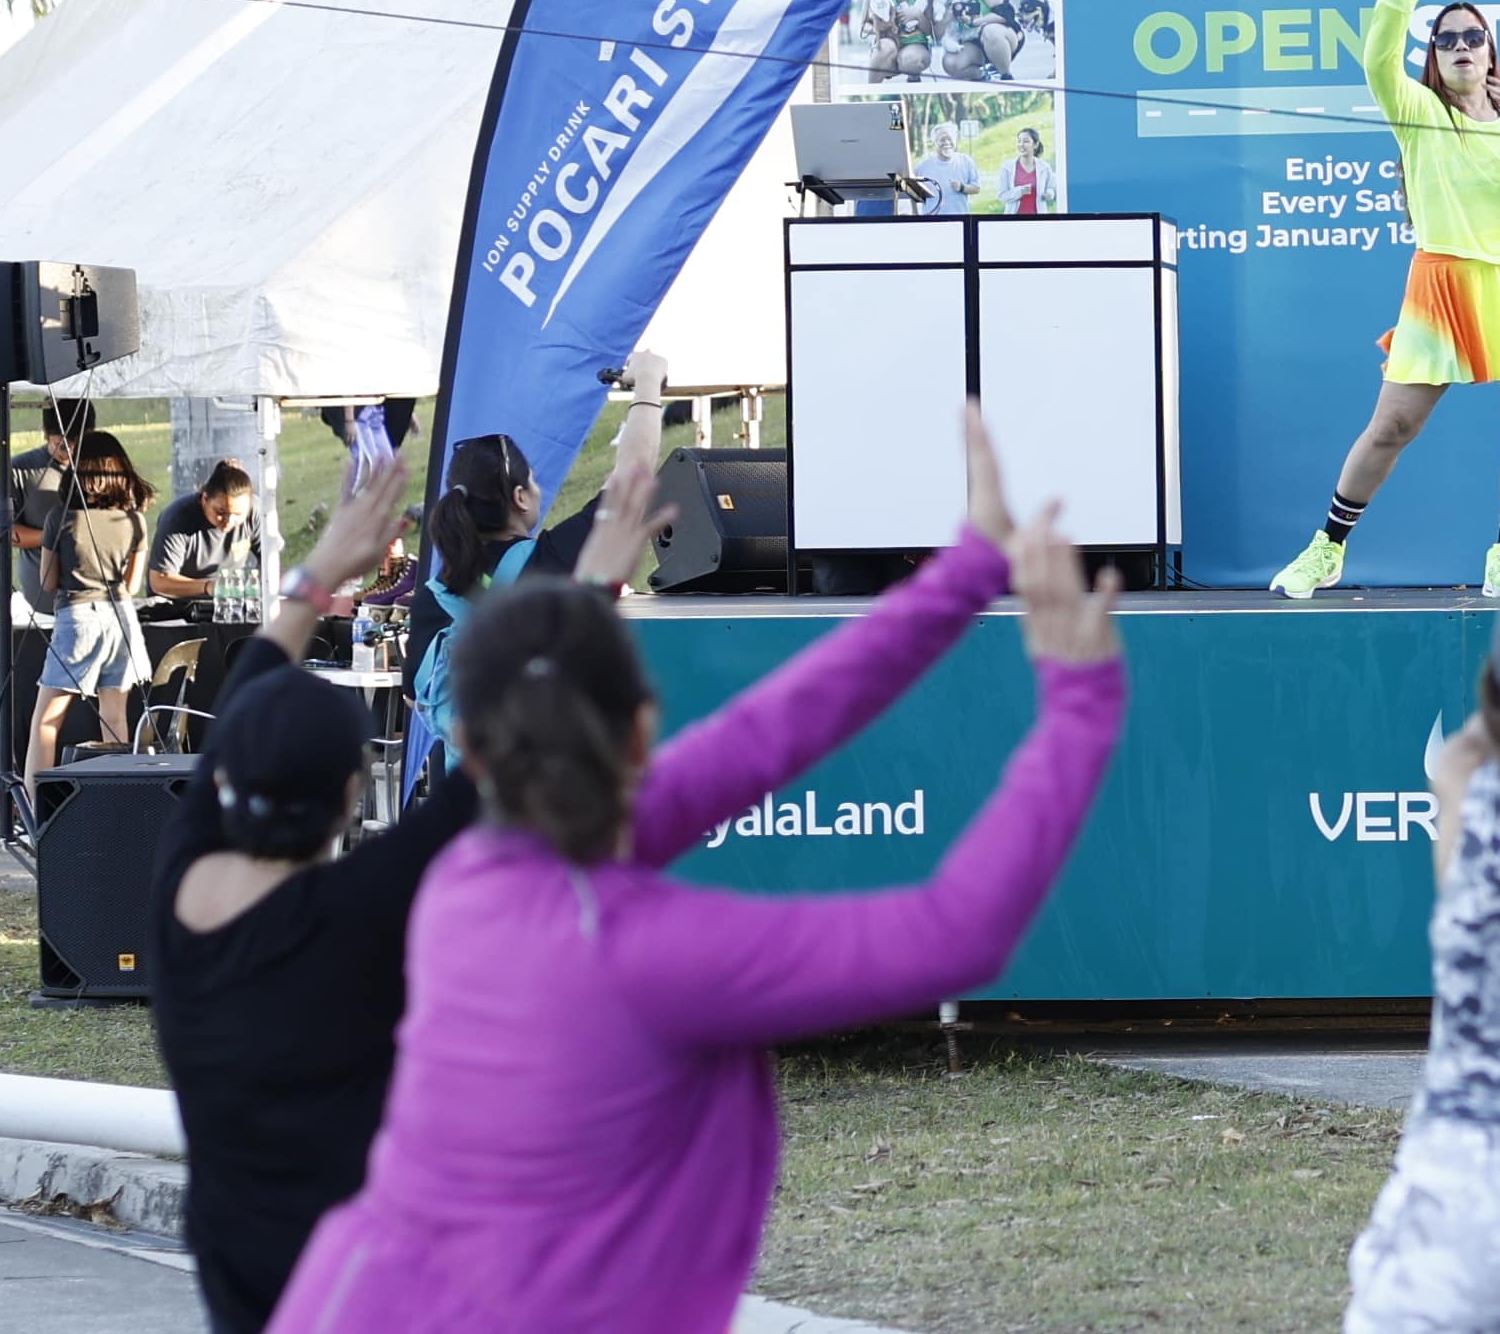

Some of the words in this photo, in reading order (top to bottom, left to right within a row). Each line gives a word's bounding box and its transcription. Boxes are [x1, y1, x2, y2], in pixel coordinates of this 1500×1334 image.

[1133, 8, 1366, 75] OPEN
[482, 234, 510, 272] ION
[507, 160, 550, 232] SUPPLY
[548, 100, 591, 162] DRINK
[498, 45, 673, 308] POCARI
[1285, 155, 1370, 185] Enjoy
[1262, 191, 1347, 218] Every
[1355, 190, 1406, 212] Sat
[1177, 225, 1247, 254] rting
[1256, 224, 1380, 251] January
[701, 789, 925, 848] yalaLand
[1309, 792, 1440, 841] VER
